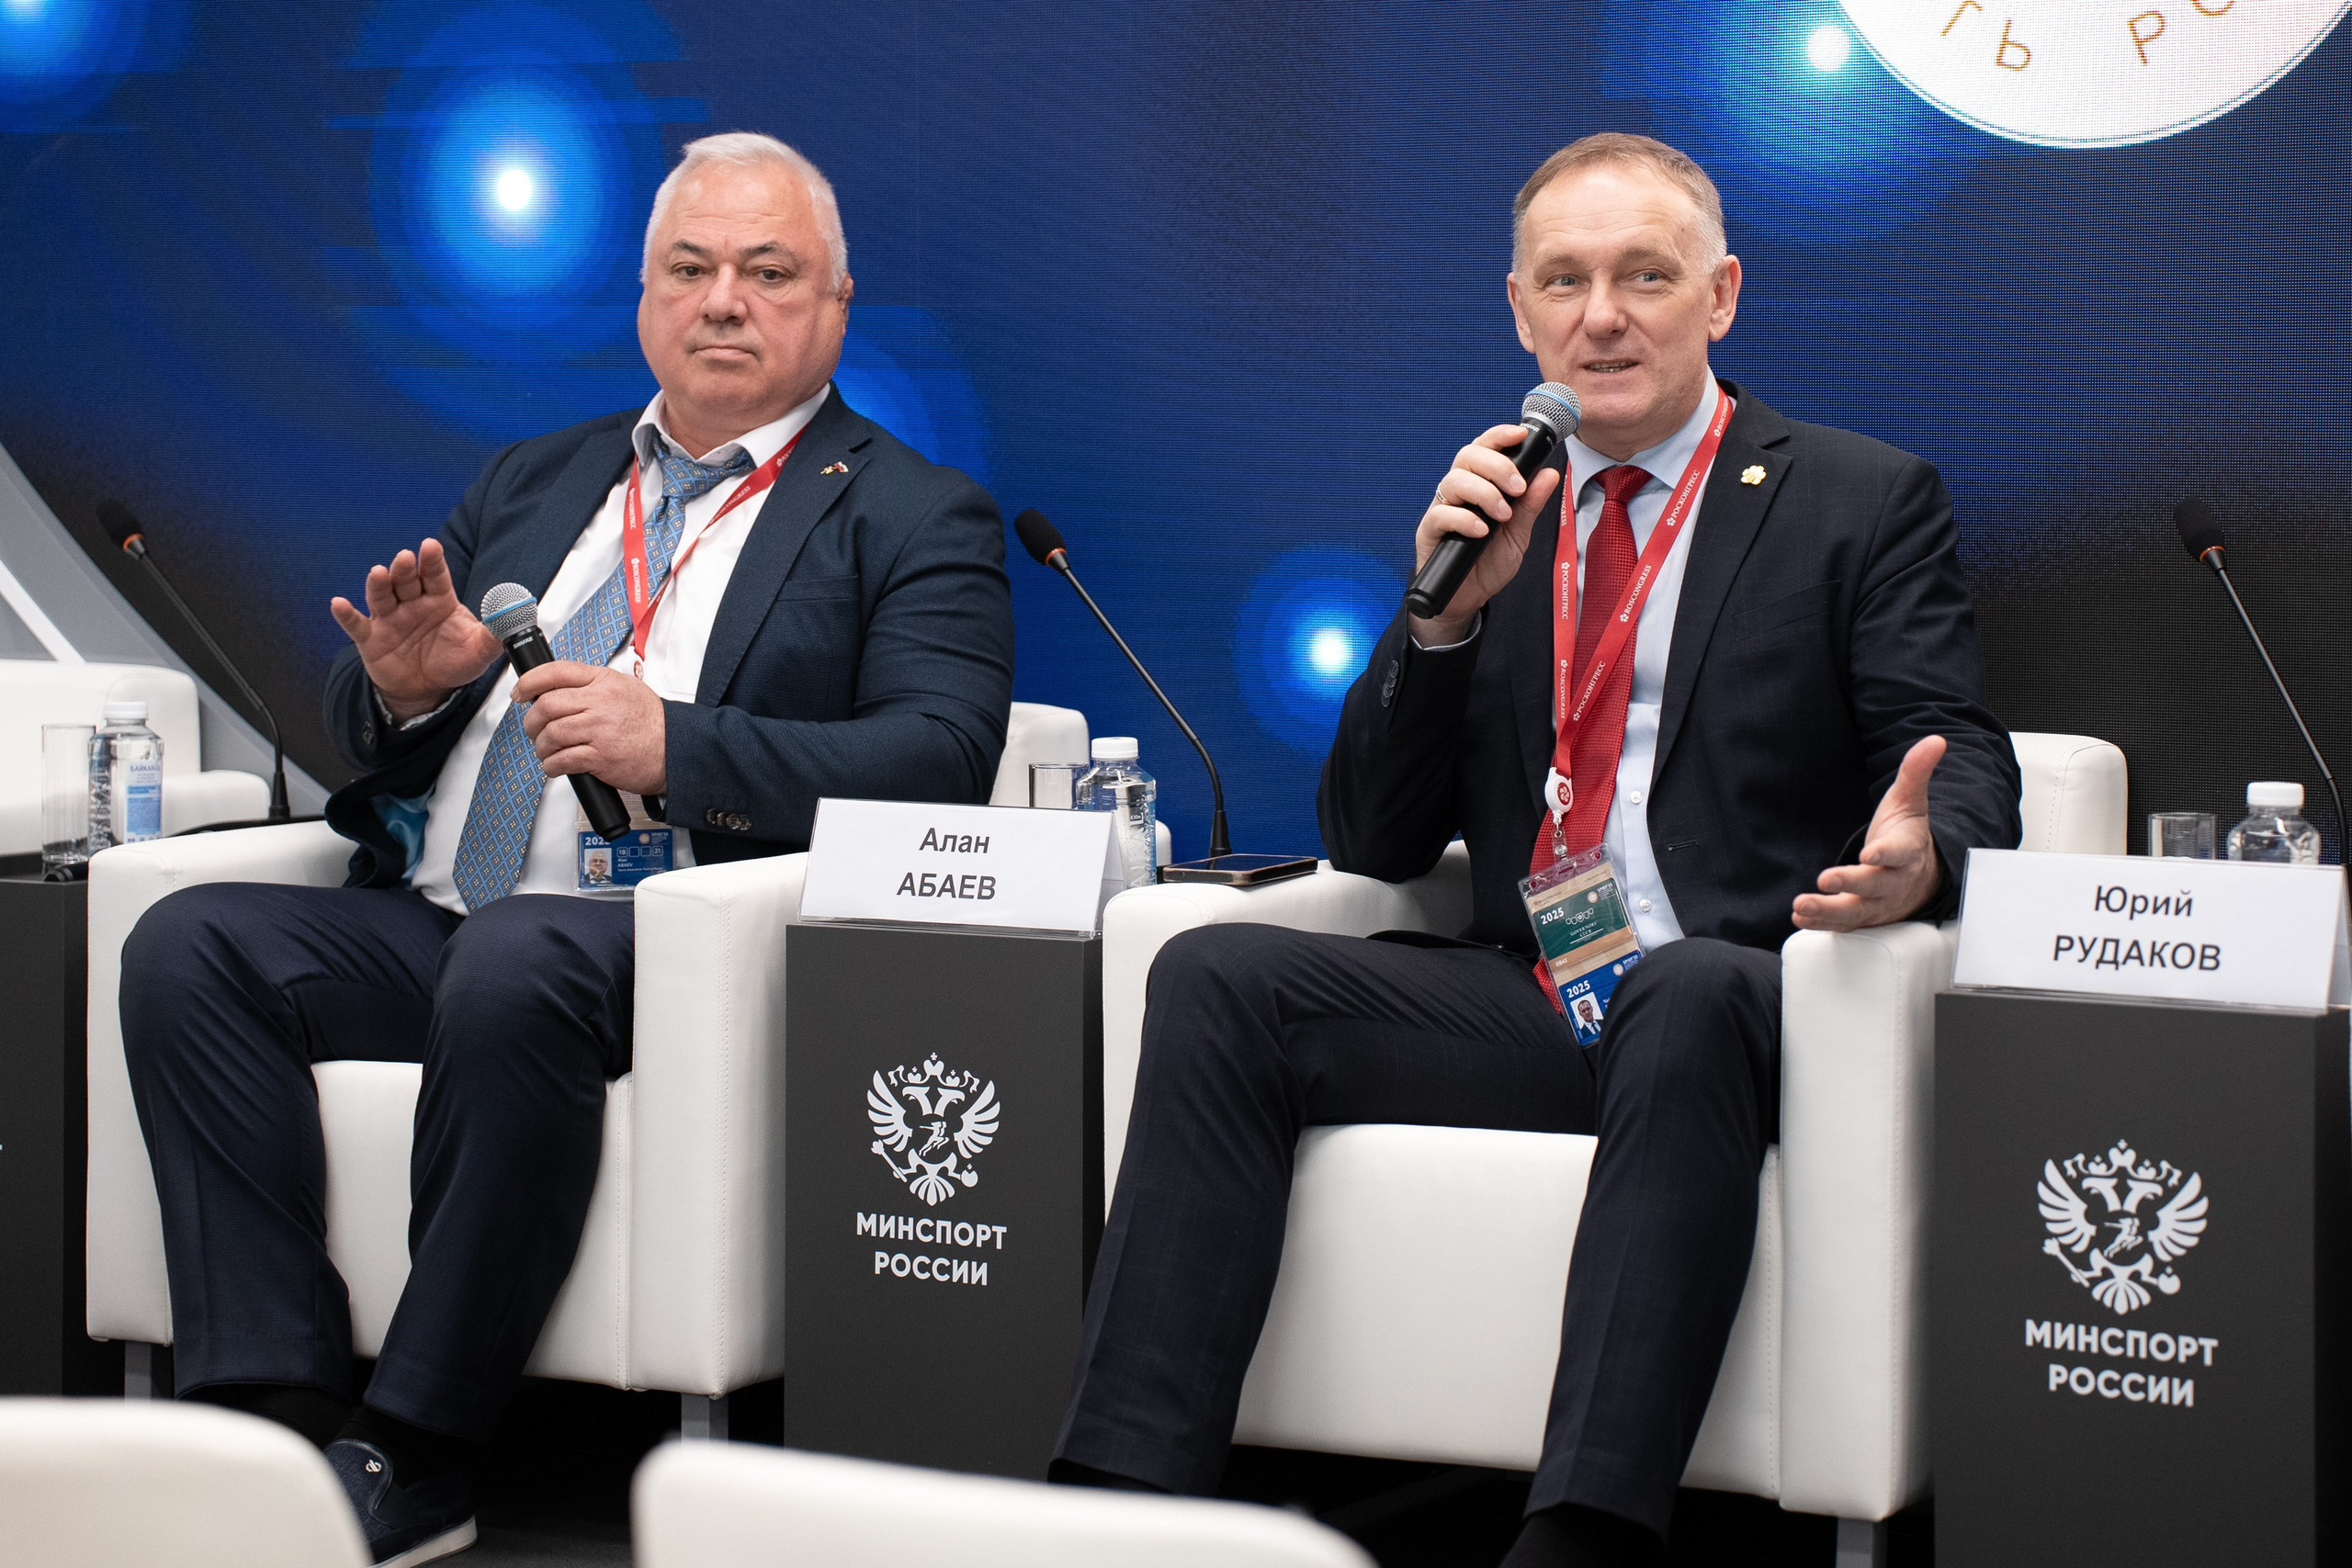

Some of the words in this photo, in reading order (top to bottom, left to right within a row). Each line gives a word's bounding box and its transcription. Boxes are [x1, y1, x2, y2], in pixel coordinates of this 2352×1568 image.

[1671, 469, 1701, 519] РОСКОНГРЕСС
[1623, 564, 1653, 615] ROSCONGRESS
[1577, 660, 1606, 714] РОСКОНГРЕСС
[919, 827, 990, 854] Алан
[896, 872, 996, 900] АБАЕВ
[2094, 885, 2194, 920] Юрий
[1541, 908, 1565, 925] 2025
[1579, 929, 1592, 937] CLUB
[2053, 934, 2221, 971] РУДАКОВ
[1566, 980, 1591, 998] 2025
[856, 1212, 1008, 1250] МИНСПОРТ
[875, 1251, 988, 1286] РОССИИ
[2025, 1318, 2220, 1367] МИНСПОРТ
[2049, 1363, 2195, 1407] РОССИИ
